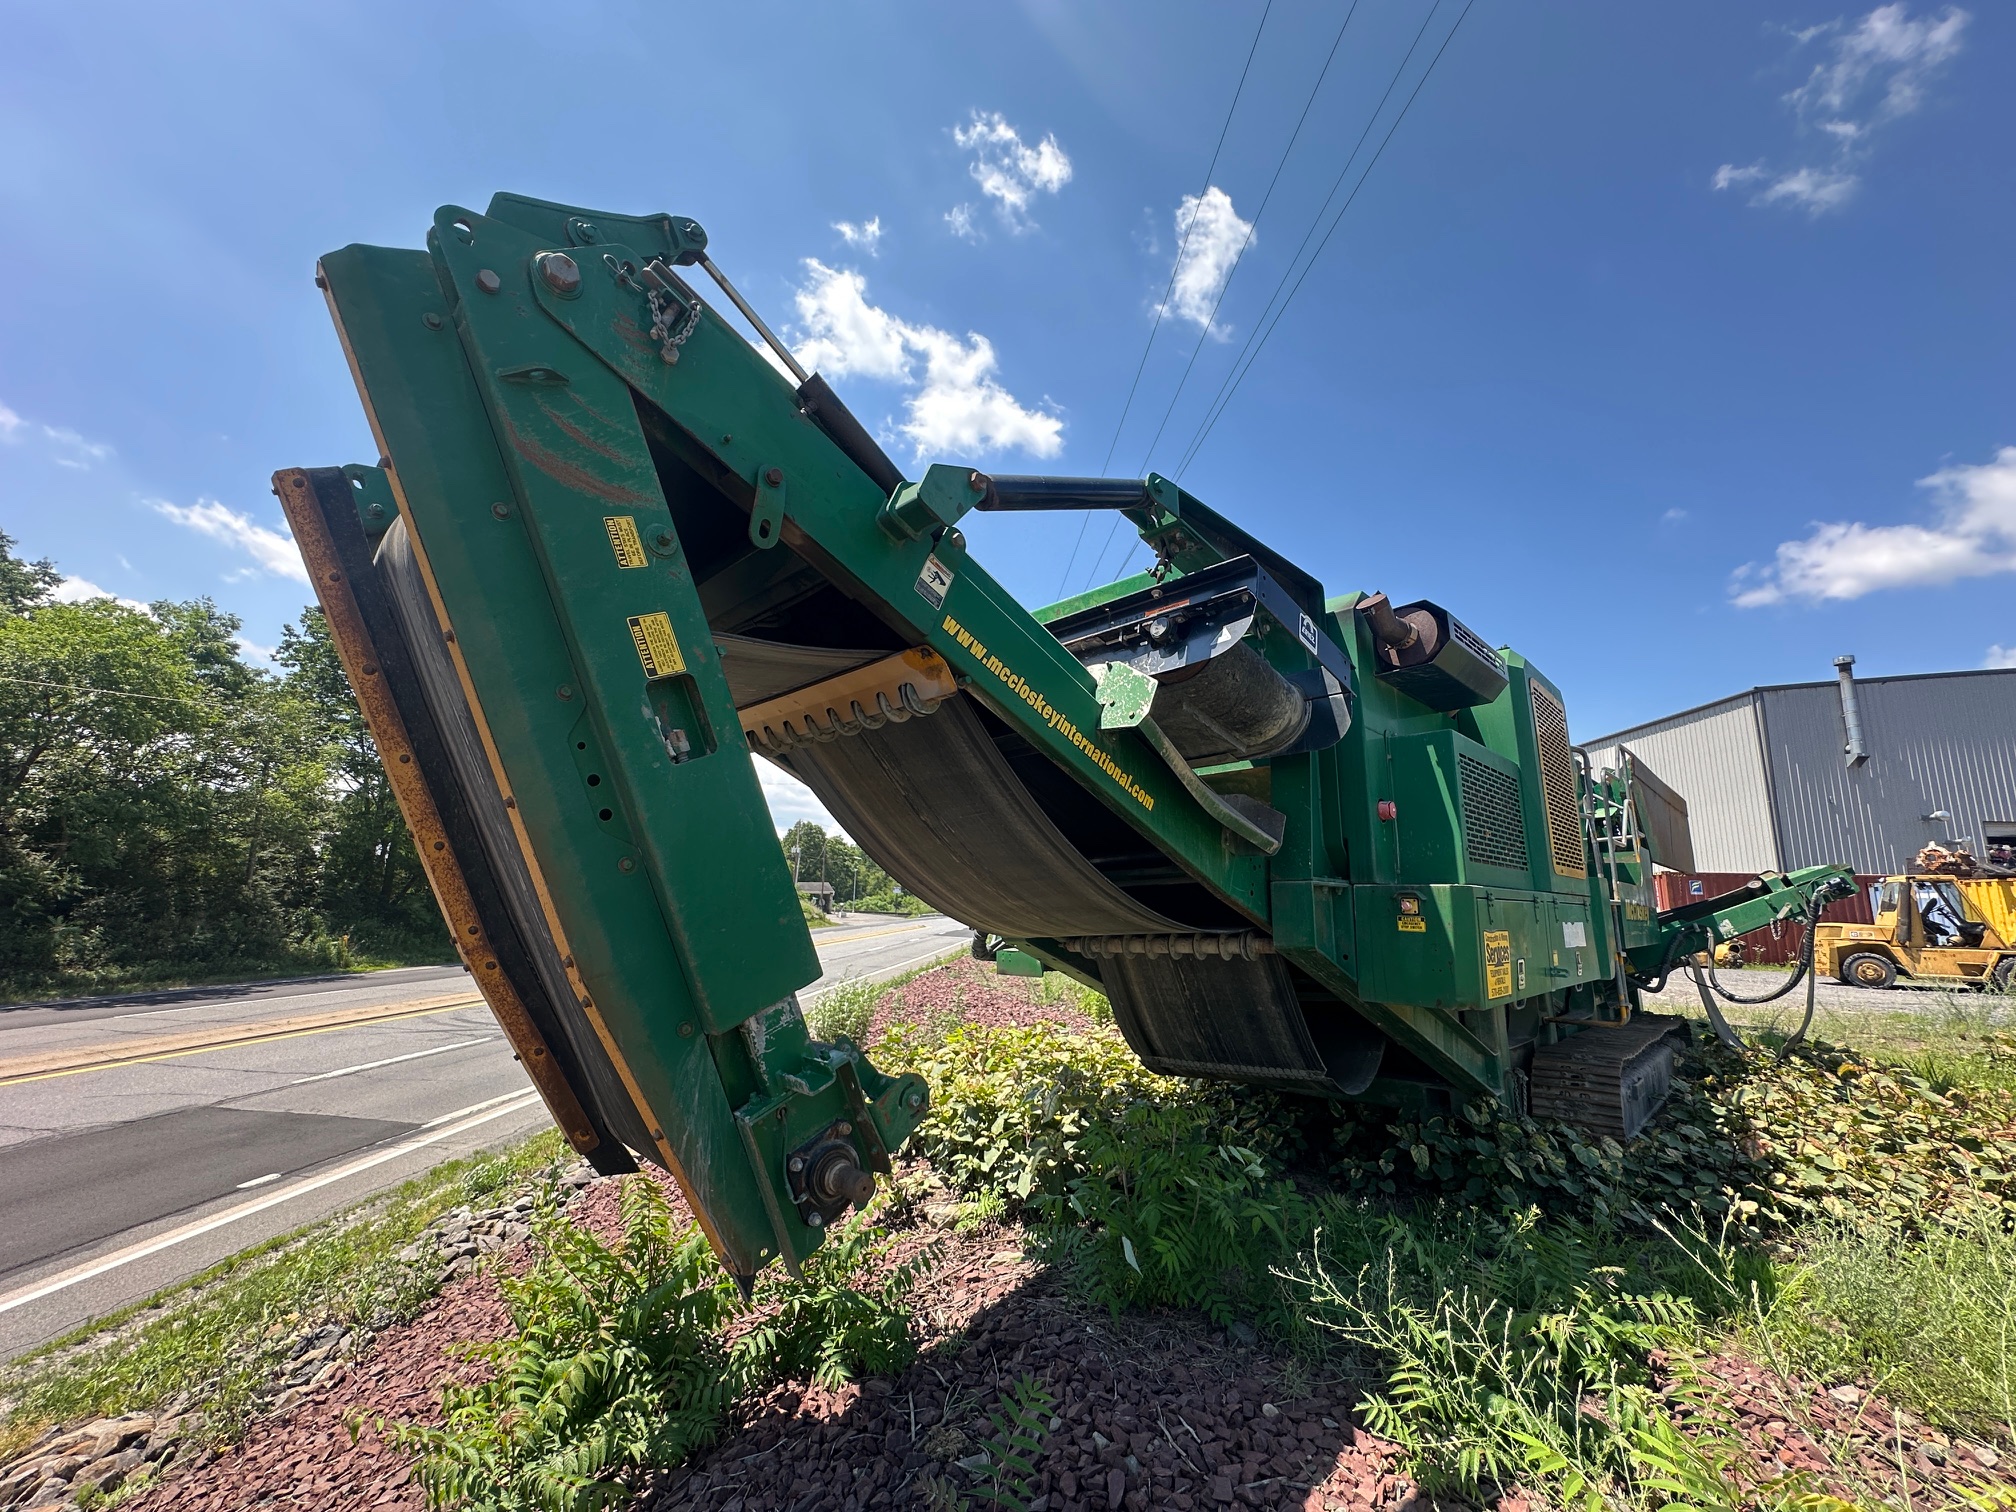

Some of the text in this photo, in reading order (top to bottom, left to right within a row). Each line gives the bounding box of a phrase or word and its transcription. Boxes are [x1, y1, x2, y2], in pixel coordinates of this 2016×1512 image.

[606, 520, 628, 566] ATTENTION
[632, 625, 655, 669] ATTENTION
[941, 615, 1155, 811] www.mccloskeyinternational.com
[1486, 942, 1510, 963] Services
